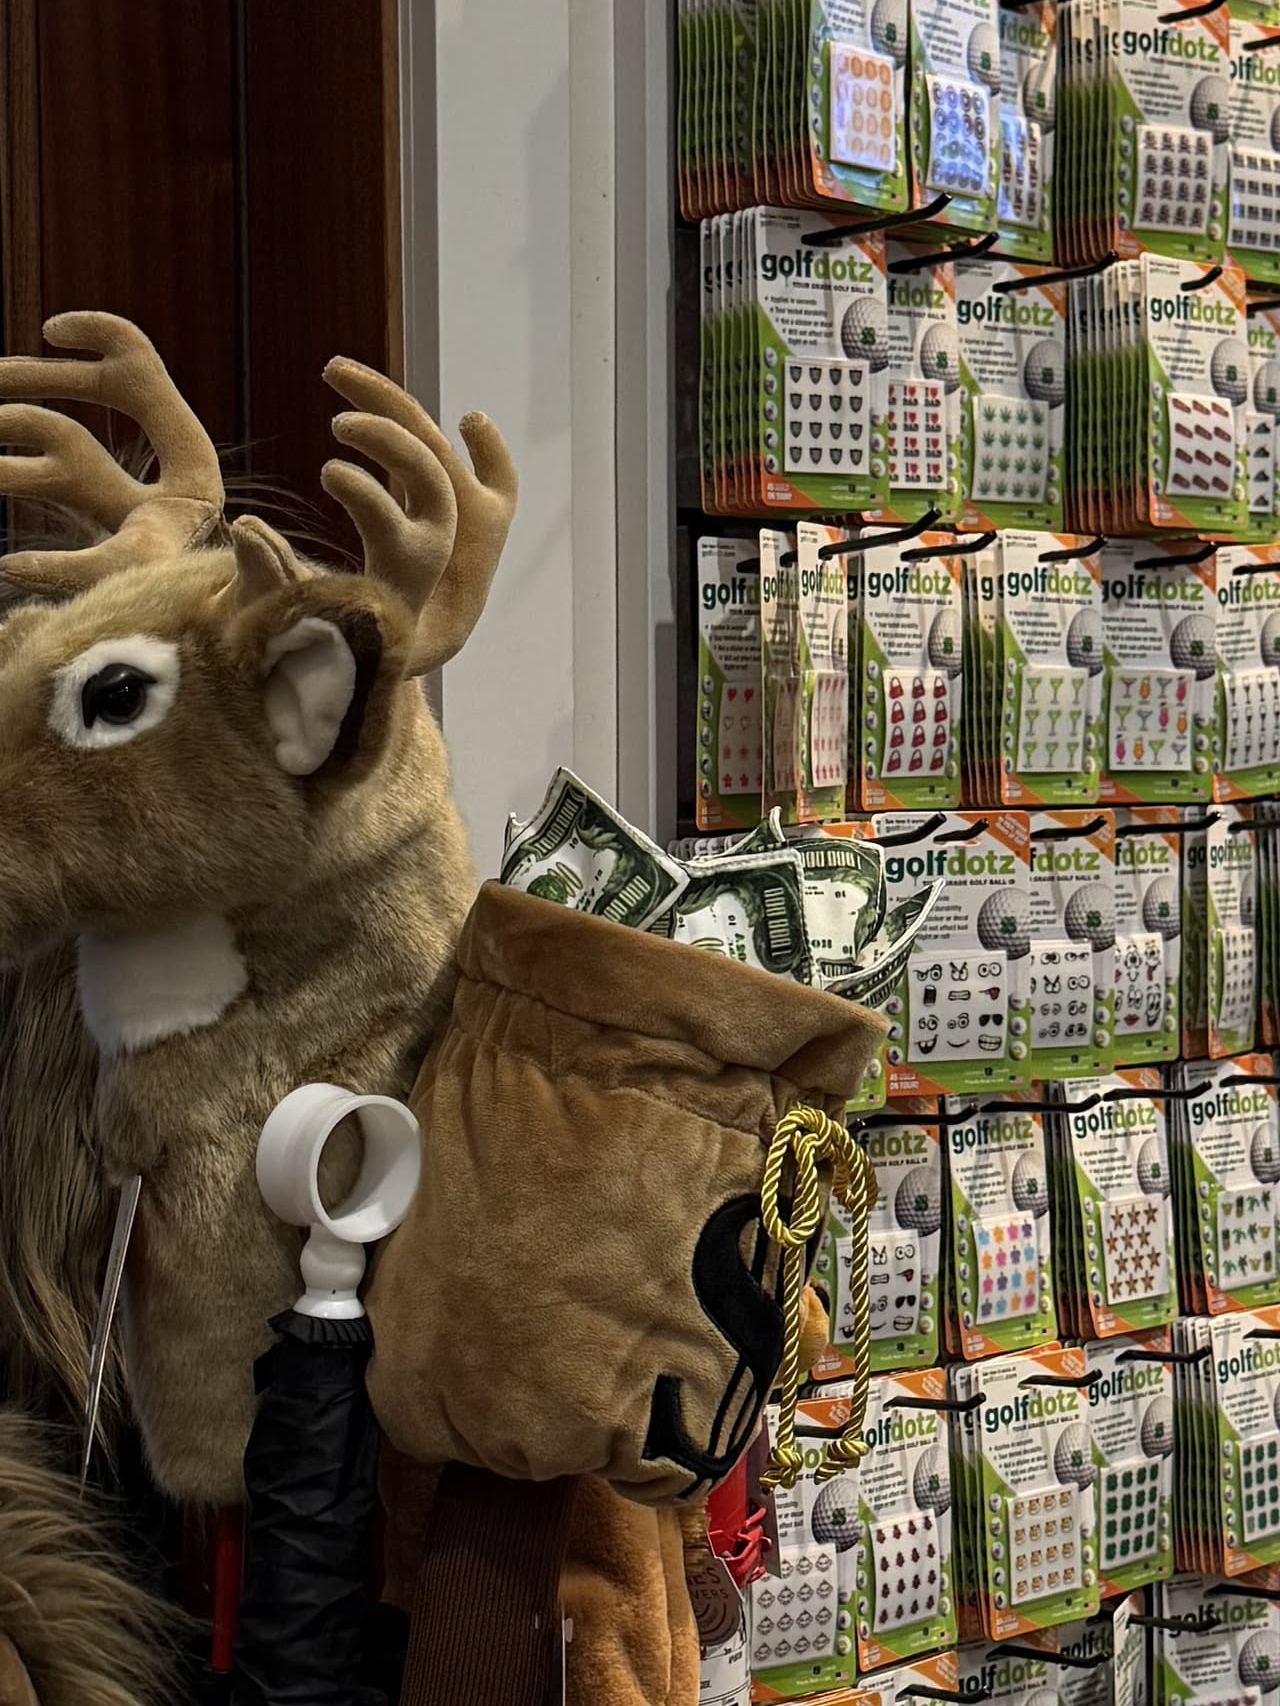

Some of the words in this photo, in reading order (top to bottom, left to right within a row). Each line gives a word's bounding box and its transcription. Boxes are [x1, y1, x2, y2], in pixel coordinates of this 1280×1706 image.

[1123, 29, 1219, 60] golfdotz
[761, 251, 873, 285] golfdotz
[957, 297, 1054, 327] golfdotz
[1150, 296, 1236, 325] golfdotz
[802, 567, 843, 599] golfdotz
[868, 568, 952, 596] golfdotz
[1007, 568, 1092, 596] golfdotz
[1102, 576, 1204, 602] golfdotz
[885, 849, 1016, 883] golfdotz
[1210, 838, 1252, 868] golfdotz
[1074, 1099, 1157, 1139] golfdotz
[1192, 1093, 1269, 1125] golfdotz
[952, 1117, 1033, 1153] golfdotz
[1089, 1365, 1163, 1406] golfdotz
[985, 1387, 1078, 1433] golfdotz
